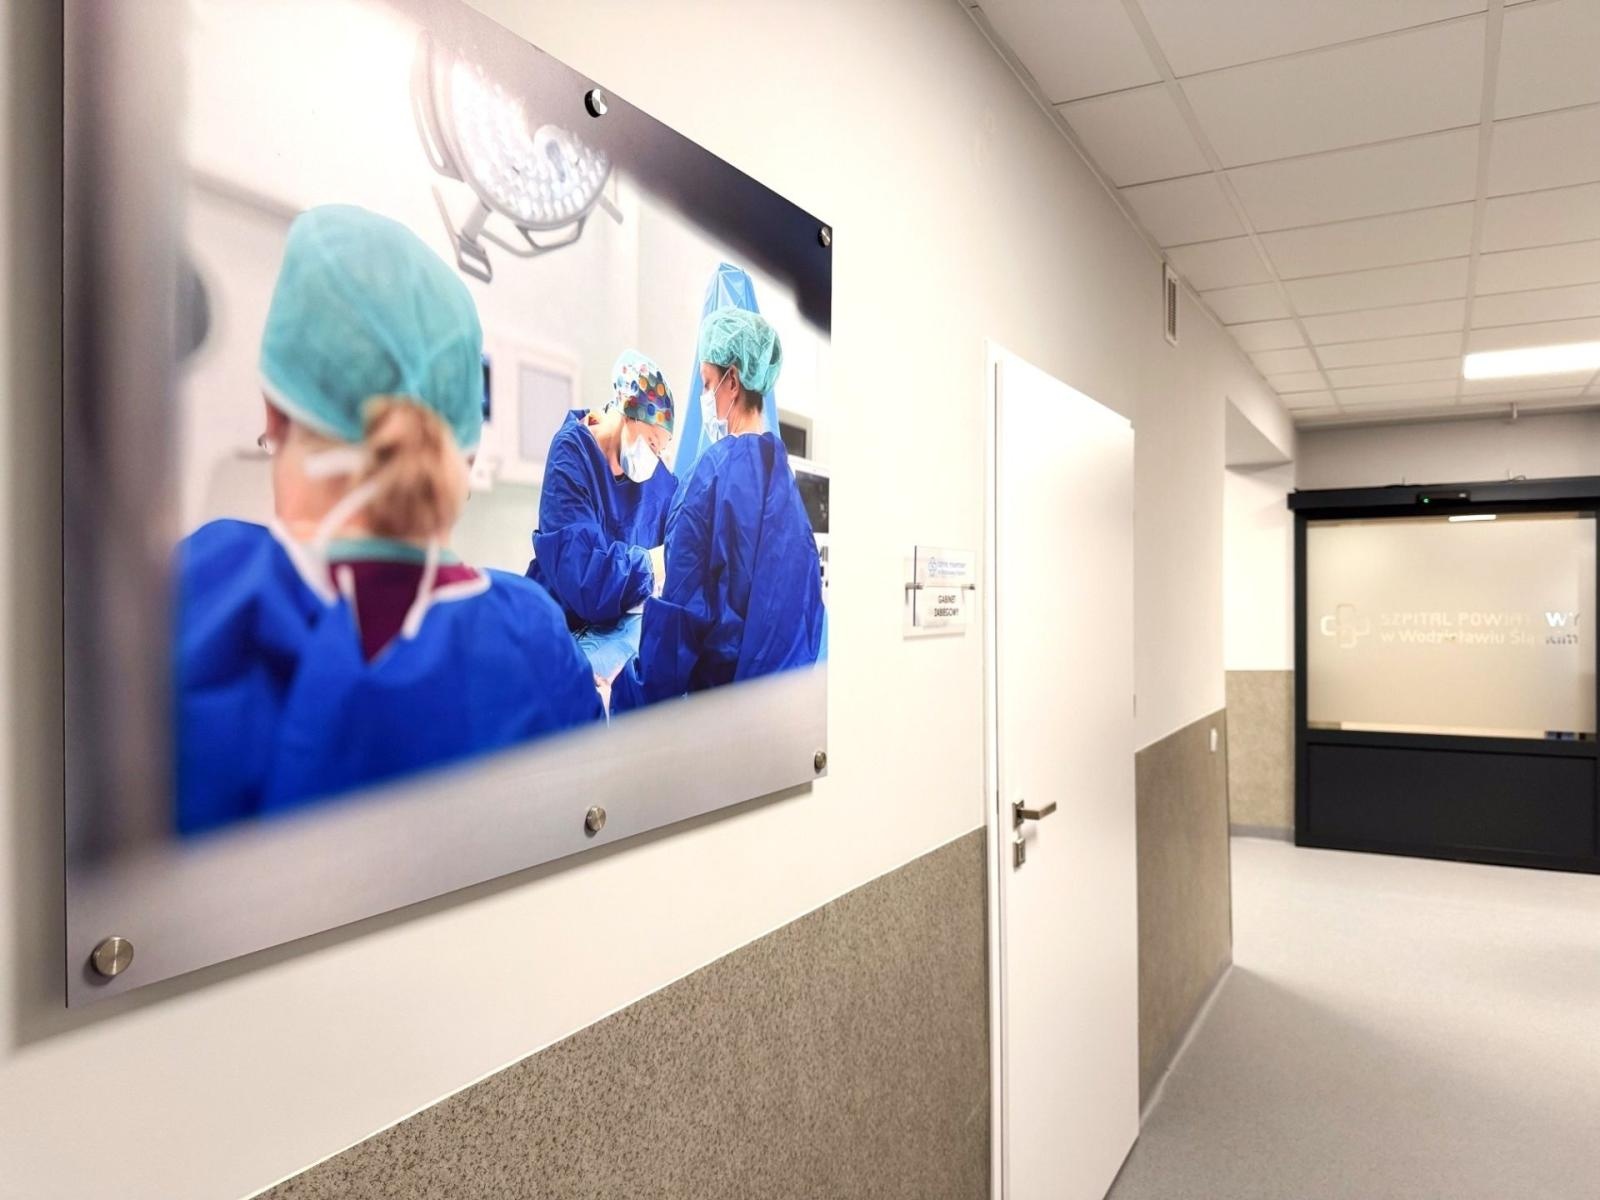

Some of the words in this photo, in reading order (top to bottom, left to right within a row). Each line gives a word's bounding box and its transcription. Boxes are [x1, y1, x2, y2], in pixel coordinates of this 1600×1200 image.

[1380, 611, 1453, 626] SZPITAL
[1458, 611, 1580, 627] POWIAWY
[1509, 627, 1578, 647] Śląkim
